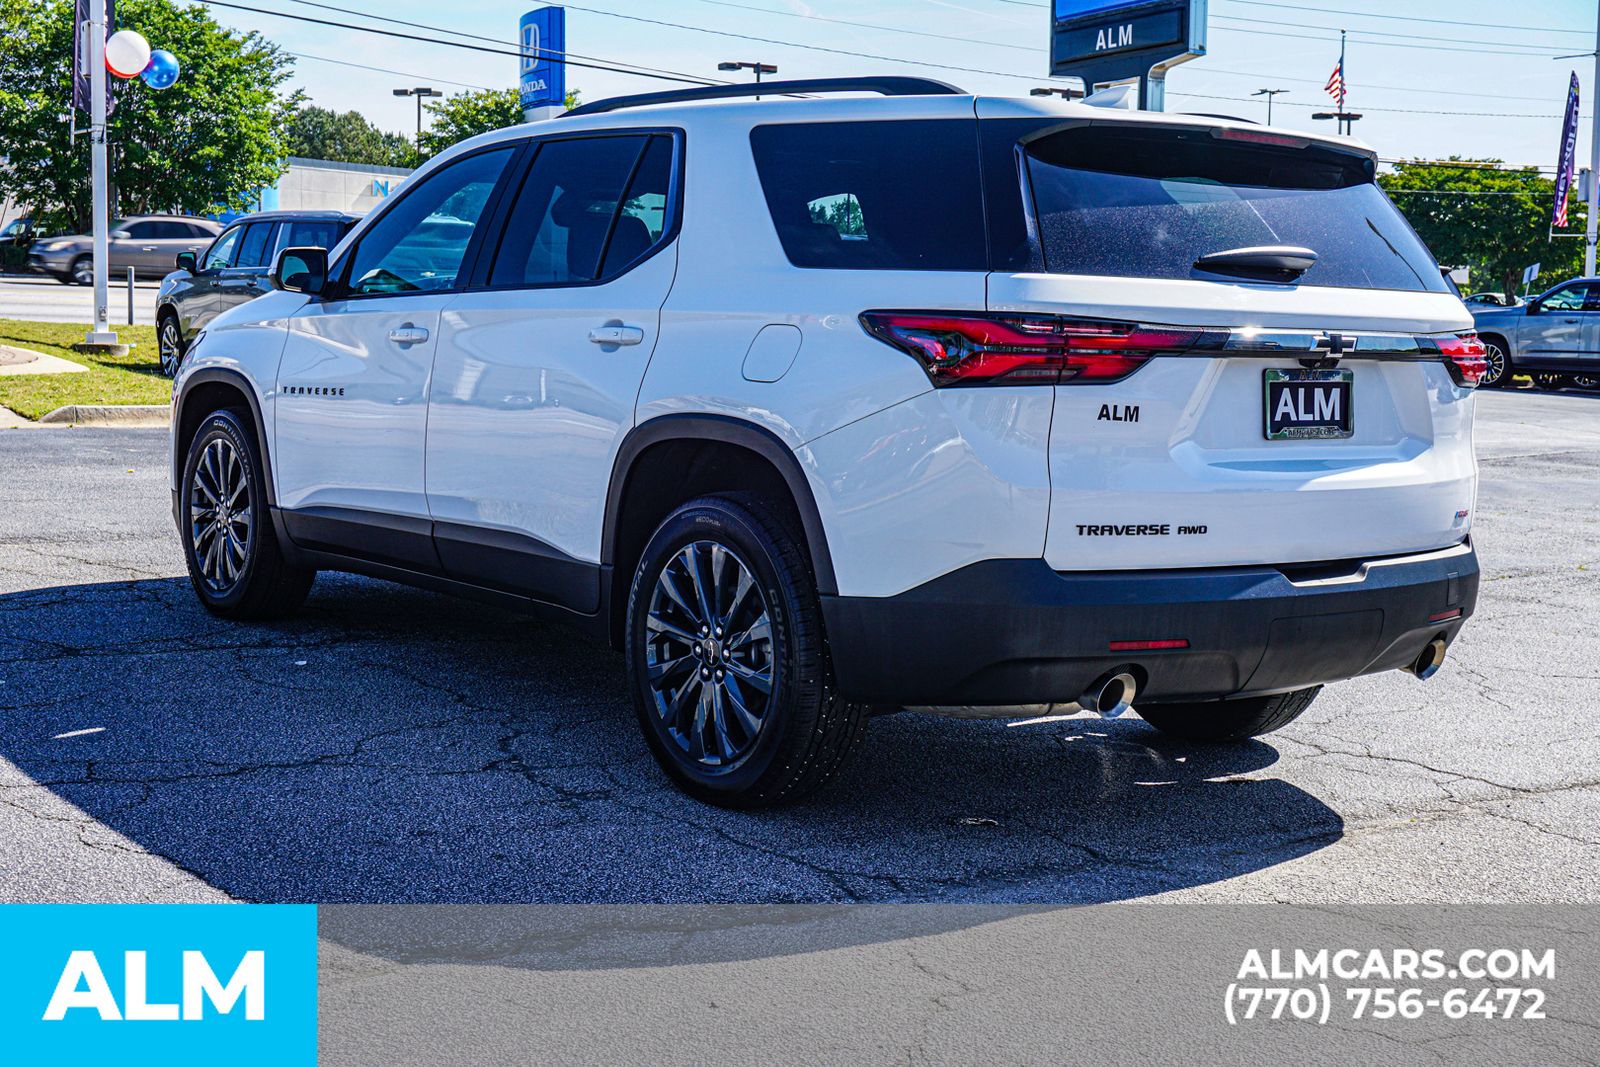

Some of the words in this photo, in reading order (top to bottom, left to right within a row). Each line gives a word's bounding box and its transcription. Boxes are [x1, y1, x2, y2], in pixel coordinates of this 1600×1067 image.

[1096, 24, 1133, 50] ALM
[520, 79, 547, 95] ONDA
[283, 386, 345, 396] TRAVERSE
[1097, 403, 1140, 423] ALM
[1274, 387, 1341, 422] ALM
[1076, 524, 1170, 536] TRAVERSE
[1177, 525, 1208, 535] AWD
